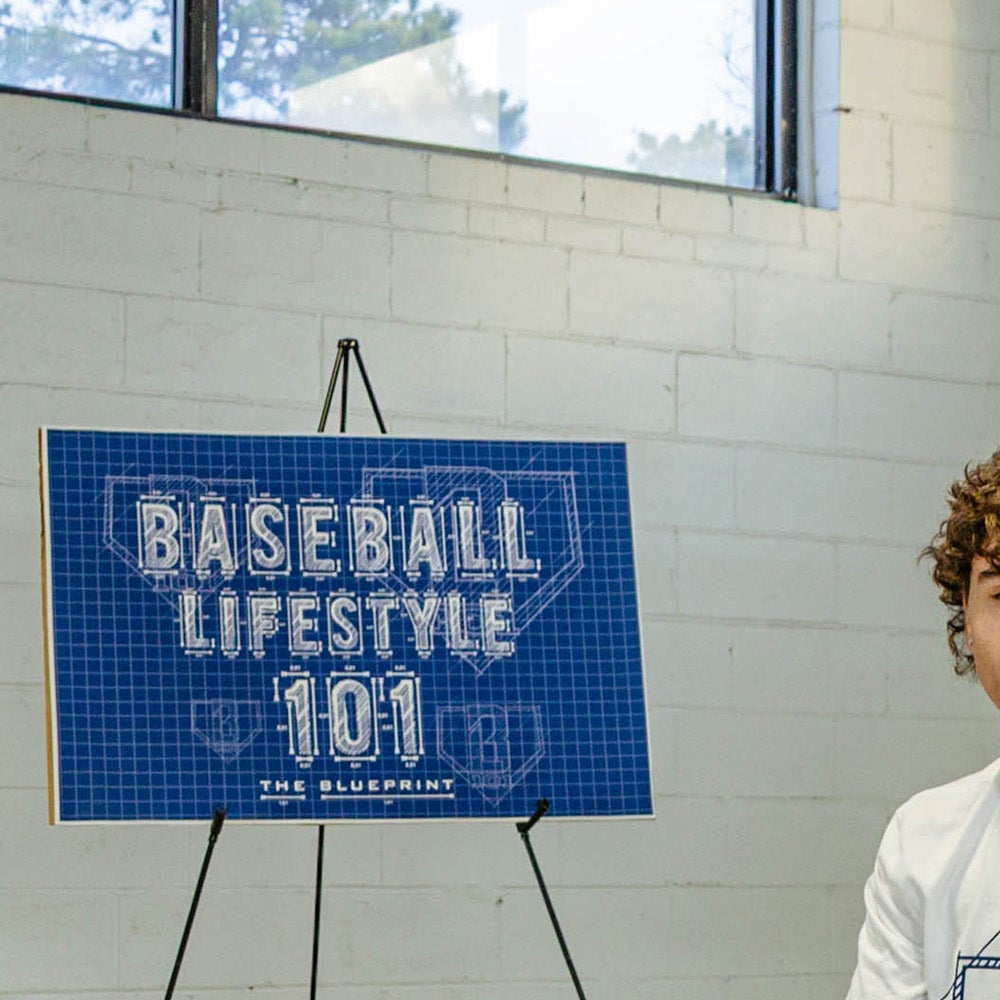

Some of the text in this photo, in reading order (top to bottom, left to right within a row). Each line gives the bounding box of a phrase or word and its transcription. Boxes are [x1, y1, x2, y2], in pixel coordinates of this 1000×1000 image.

[141, 503, 535, 571] BASEBALL
[183, 594, 512, 652] LIFESTYLE
[284, 678, 418, 756] 101
[259, 778, 455, 792] THE BLUEPRINT
